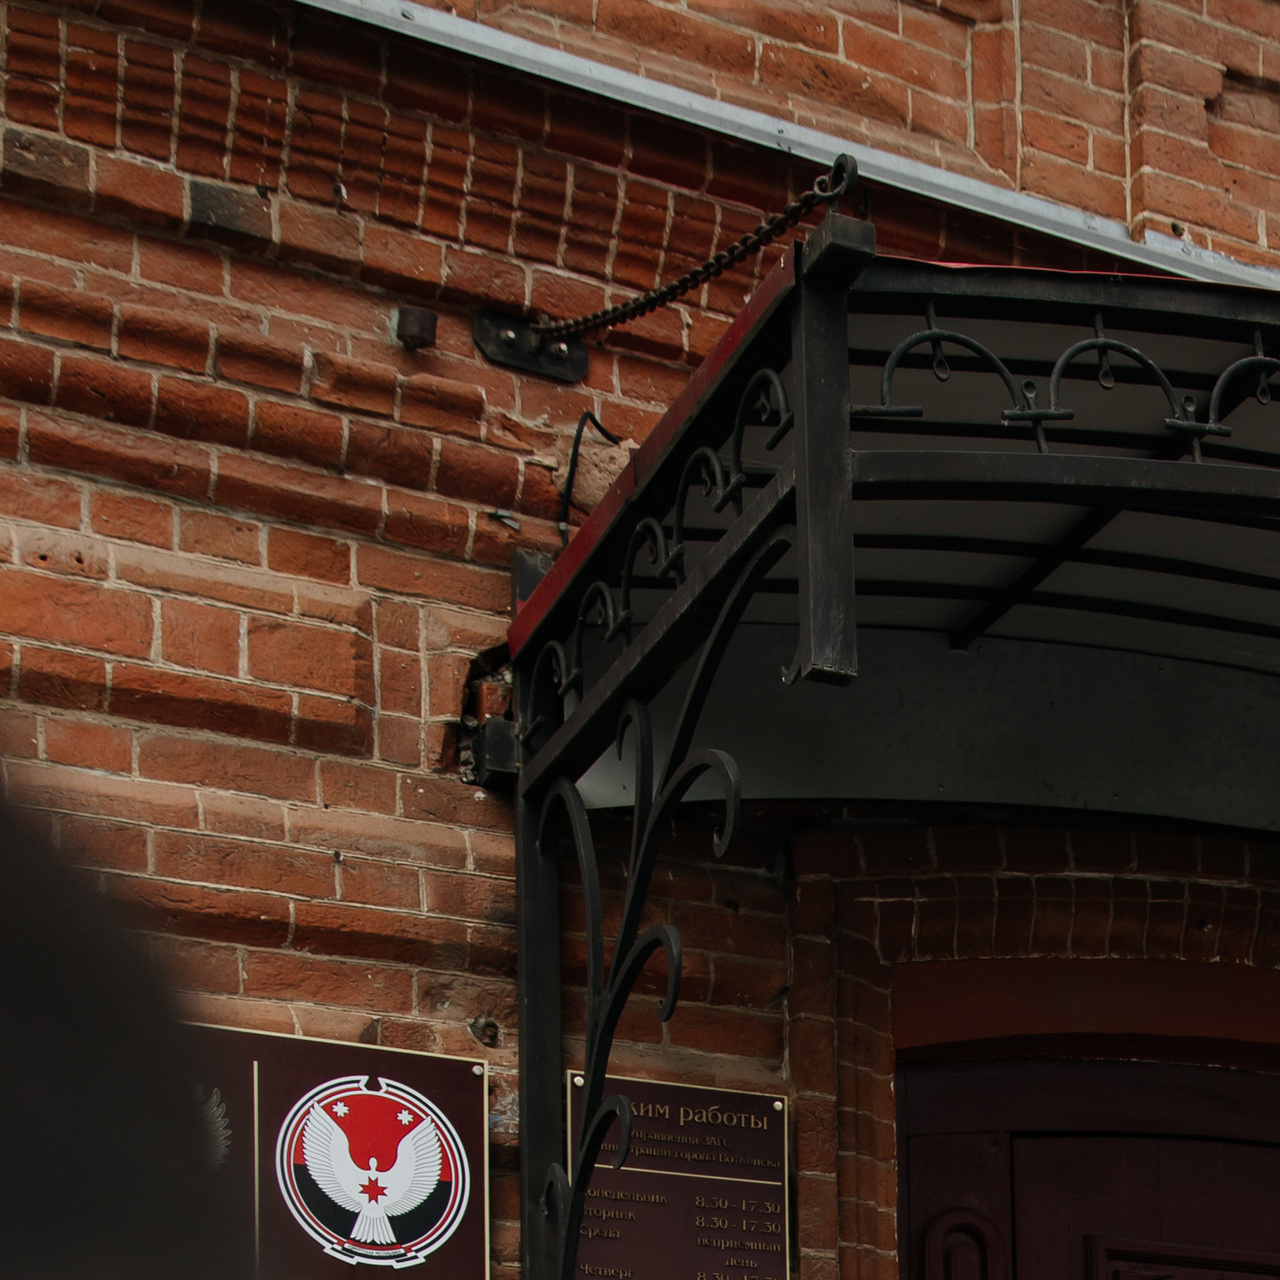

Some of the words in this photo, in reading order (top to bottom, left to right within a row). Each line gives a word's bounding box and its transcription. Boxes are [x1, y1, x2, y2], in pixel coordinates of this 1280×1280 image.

[680, 1105, 768, 1130] работы
[704, 1136, 731, 1148] ЗАГС
[674, 1150, 715, 1162] города
[719, 1153, 781, 1168] Воткинска
[585, 1188, 668, 1204] онедельник
[695, 1195, 728, 1209] 8.30
[741, 1200, 781, 1214] 17.30
[579, 1223, 620, 1240] Среда
[695, 1216, 728, 1229] 8.30
[742, 1219, 781, 1234] 17.30
[579, 1263, 634, 1280] Четверг
[725, 1257, 758, 1269] день
